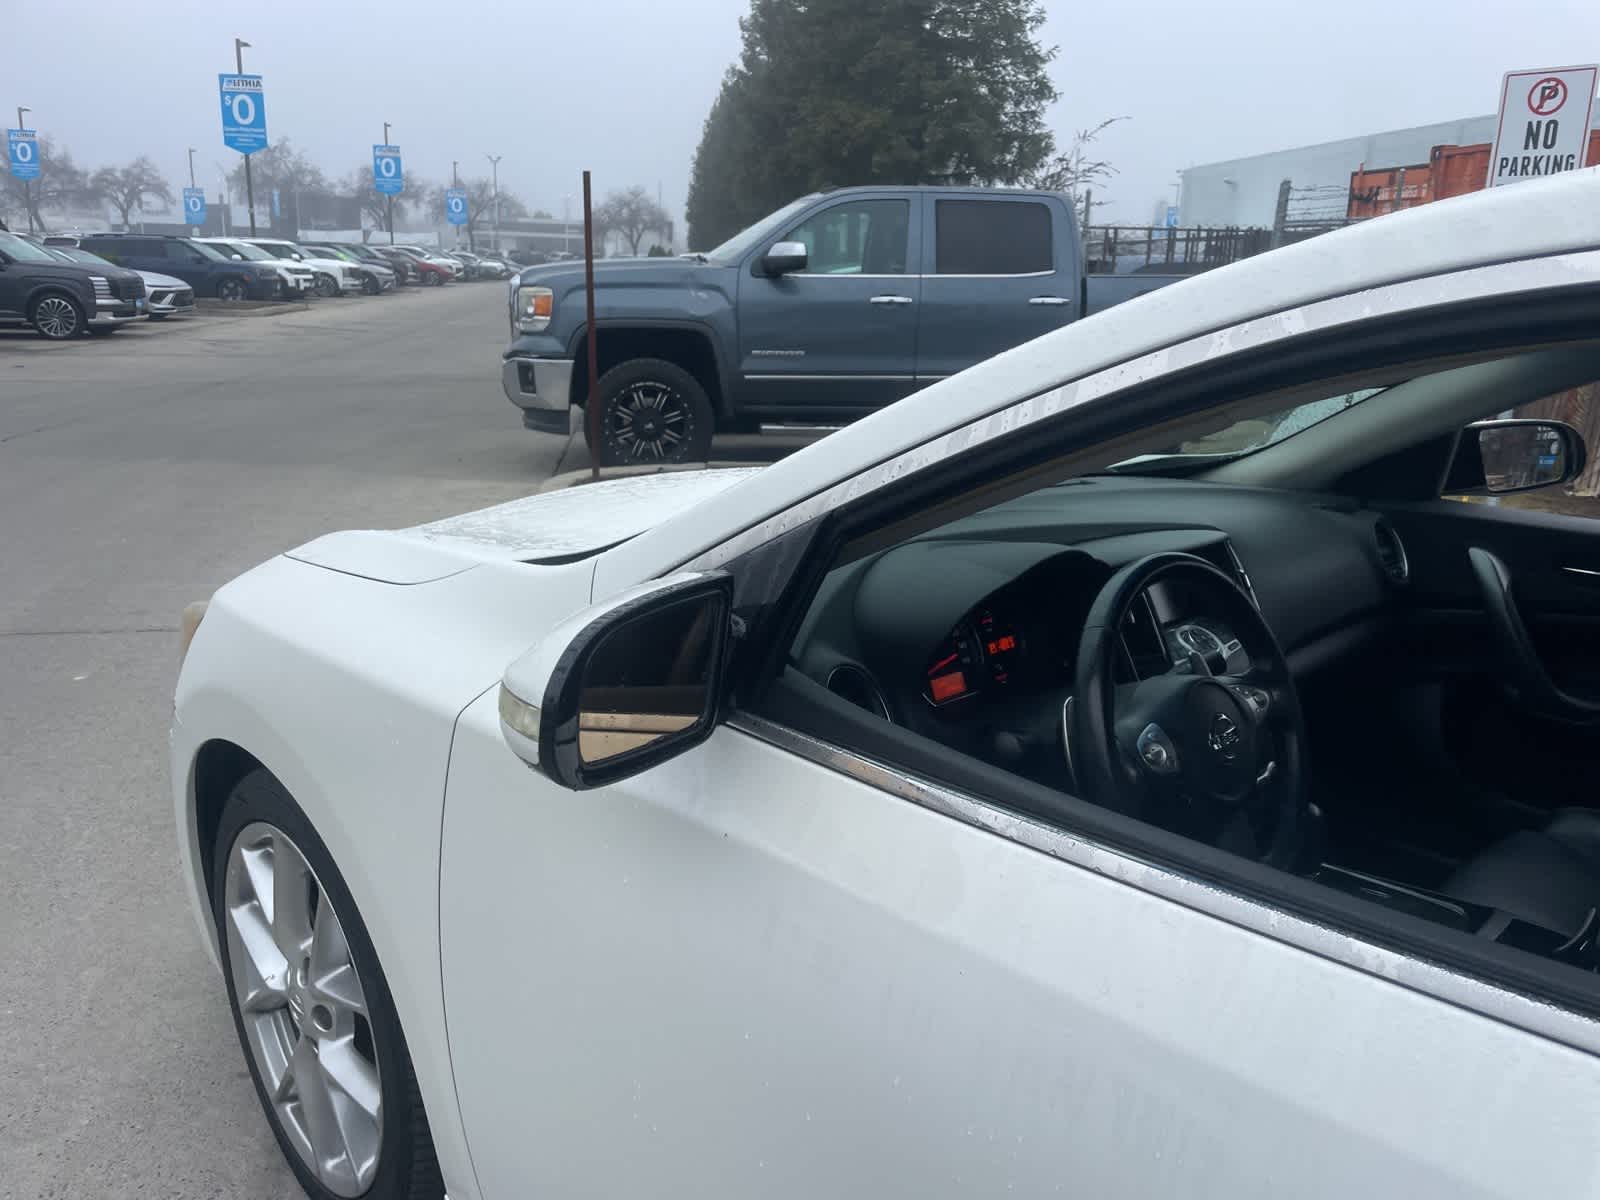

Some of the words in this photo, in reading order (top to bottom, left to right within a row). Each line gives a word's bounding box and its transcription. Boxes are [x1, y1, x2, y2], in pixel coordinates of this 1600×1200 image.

[233, 79, 262, 88] LITHIA
[1524, 119, 1559, 150] NO
[1498, 153, 1575, 176] PARKING
